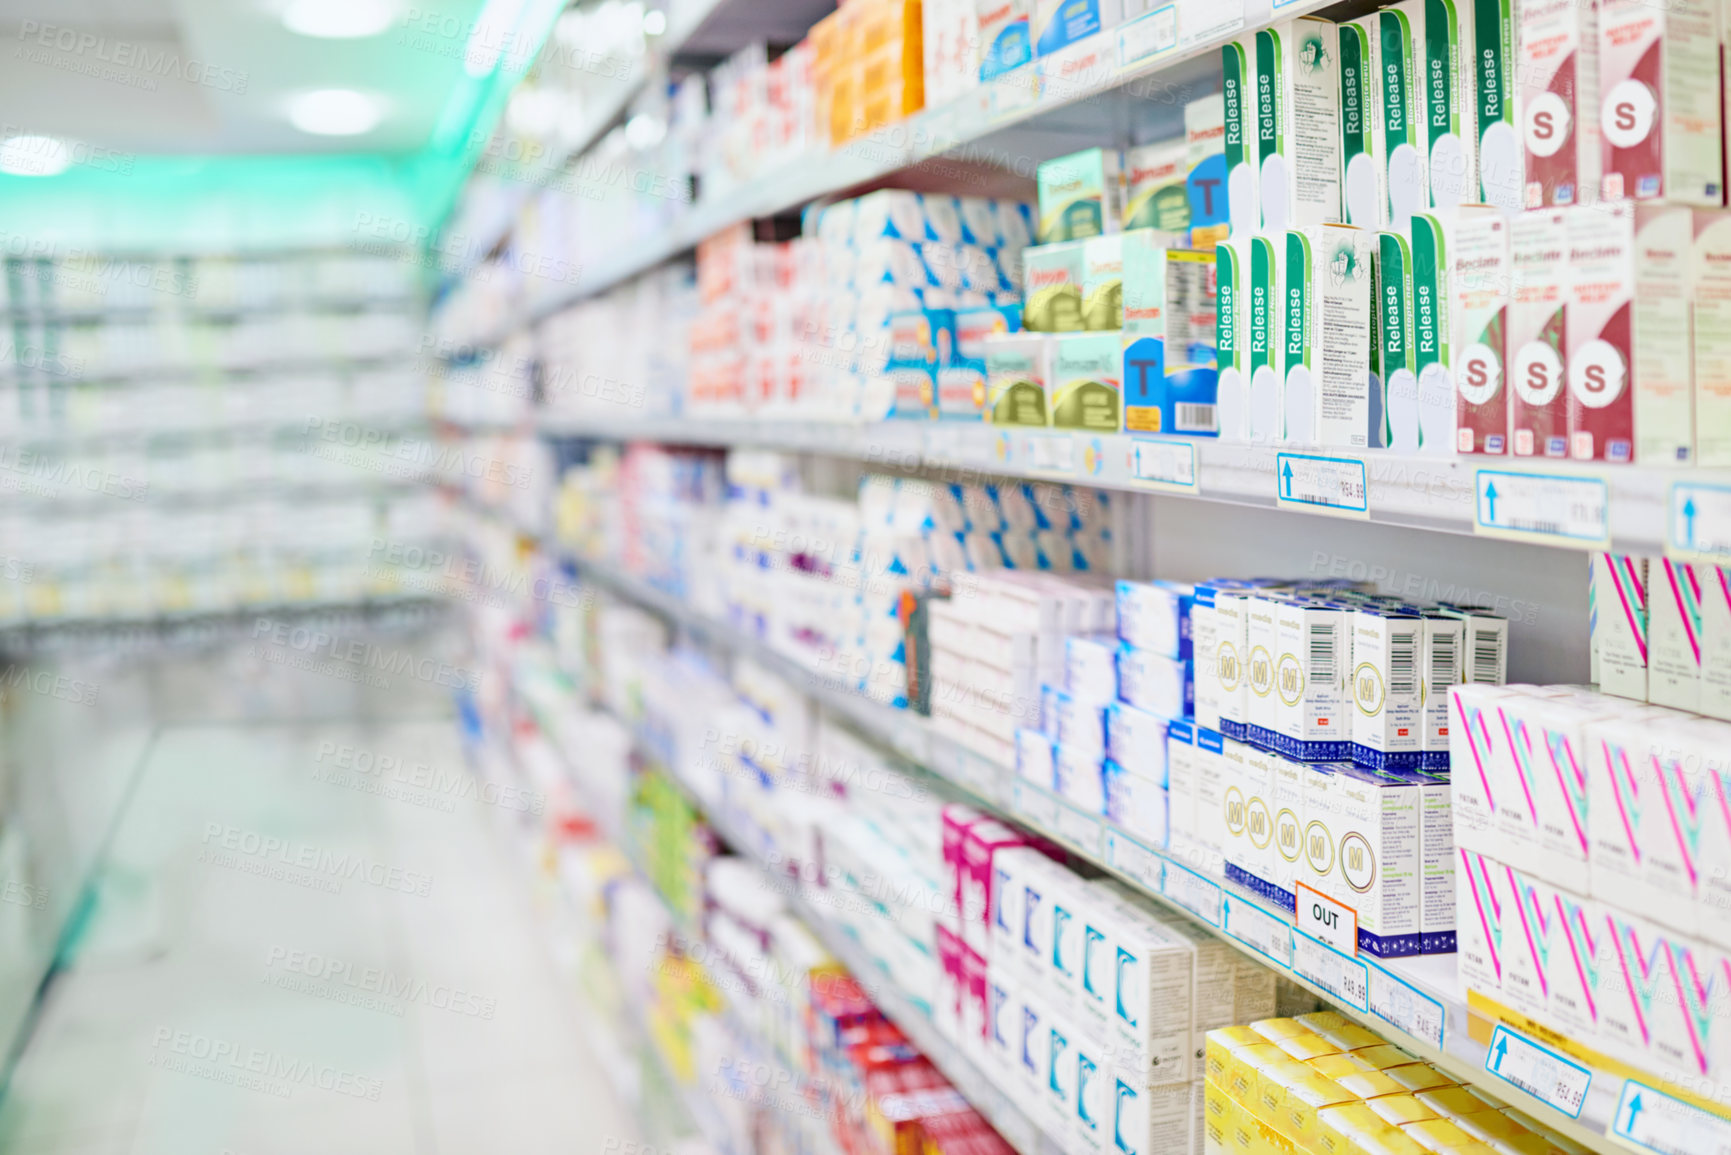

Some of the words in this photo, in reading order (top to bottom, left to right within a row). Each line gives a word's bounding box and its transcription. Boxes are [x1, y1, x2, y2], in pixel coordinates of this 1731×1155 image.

[1431, 58, 1447, 127] Release
[1482, 48, 1499, 117] Release
[1259, 73, 1275, 141] Release
[1344, 66, 1360, 134] Release
[1386, 63, 1402, 131] Release
[1226, 78, 1240, 145] Release
[1533, 111, 1553, 140] S
[1615, 102, 1636, 130] S
[1194, 178, 1222, 217] T
[1220, 285, 1233, 352] Release
[1252, 286, 1265, 353] Release
[1289, 287, 1302, 355] Release
[1387, 285, 1402, 353] Release
[1419, 285, 1435, 353] Release
[1129, 359, 1156, 397] T
[1467, 359, 1488, 387] S
[1527, 362, 1548, 390] S
[1584, 365, 1606, 393] S
[1221, 656, 1235, 680] M
[1253, 661, 1267, 685] M
[1283, 668, 1297, 691] M
[1360, 678, 1375, 702] M
[1229, 801, 1242, 824] M
[1251, 812, 1265, 835] M
[1281, 824, 1295, 848] M
[1311, 836, 1325, 860] M
[1349, 847, 1363, 871] M
[1312, 903, 1339, 930] OUT
